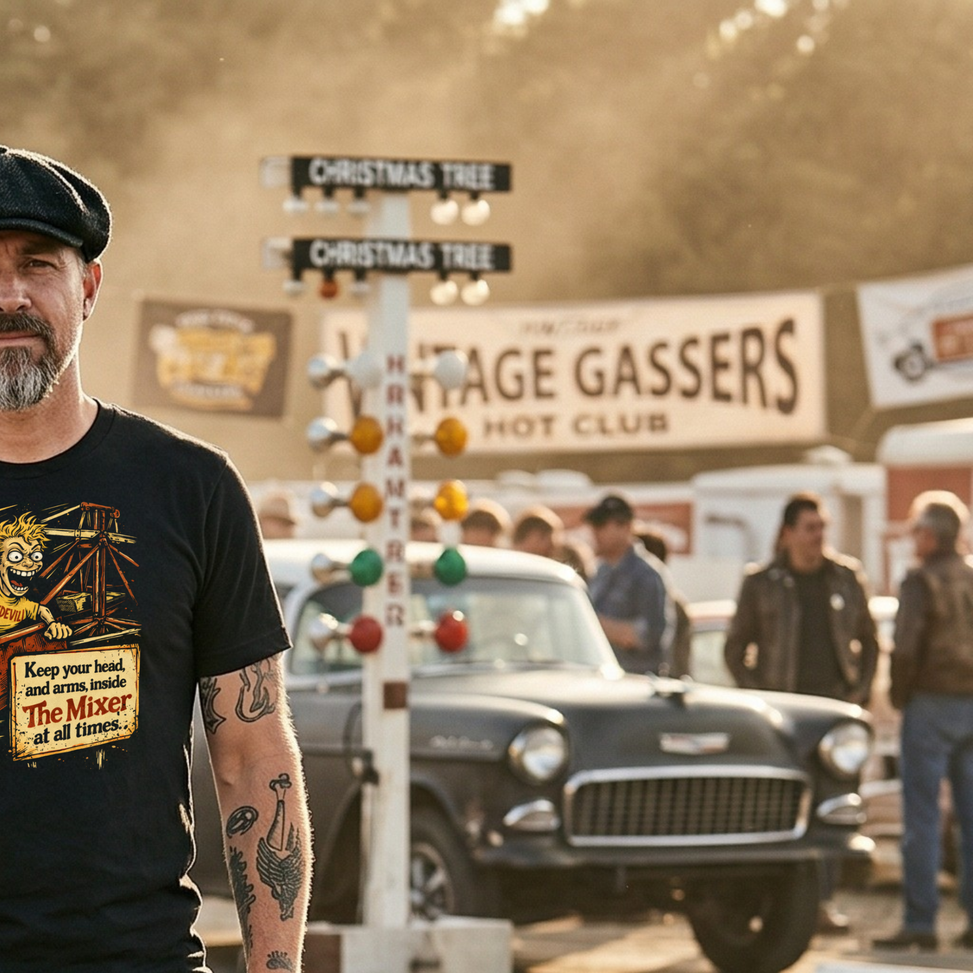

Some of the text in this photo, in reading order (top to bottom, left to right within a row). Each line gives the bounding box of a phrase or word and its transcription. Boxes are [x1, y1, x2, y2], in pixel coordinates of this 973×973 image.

[309, 157, 495, 190] CHRISTMAS TREE
[310, 239, 495, 270] CHRISTMAS TREE
[574, 318, 798, 414] GASSERS
[483, 411, 668, 437] HOT CLUB
[24, 657, 126, 680] Keep your head,
[25, 674, 127, 697] and arms, inside
[22, 693, 133, 729] The Mixer
[33, 728, 50, 746] at
[53, 723, 71, 742] all
